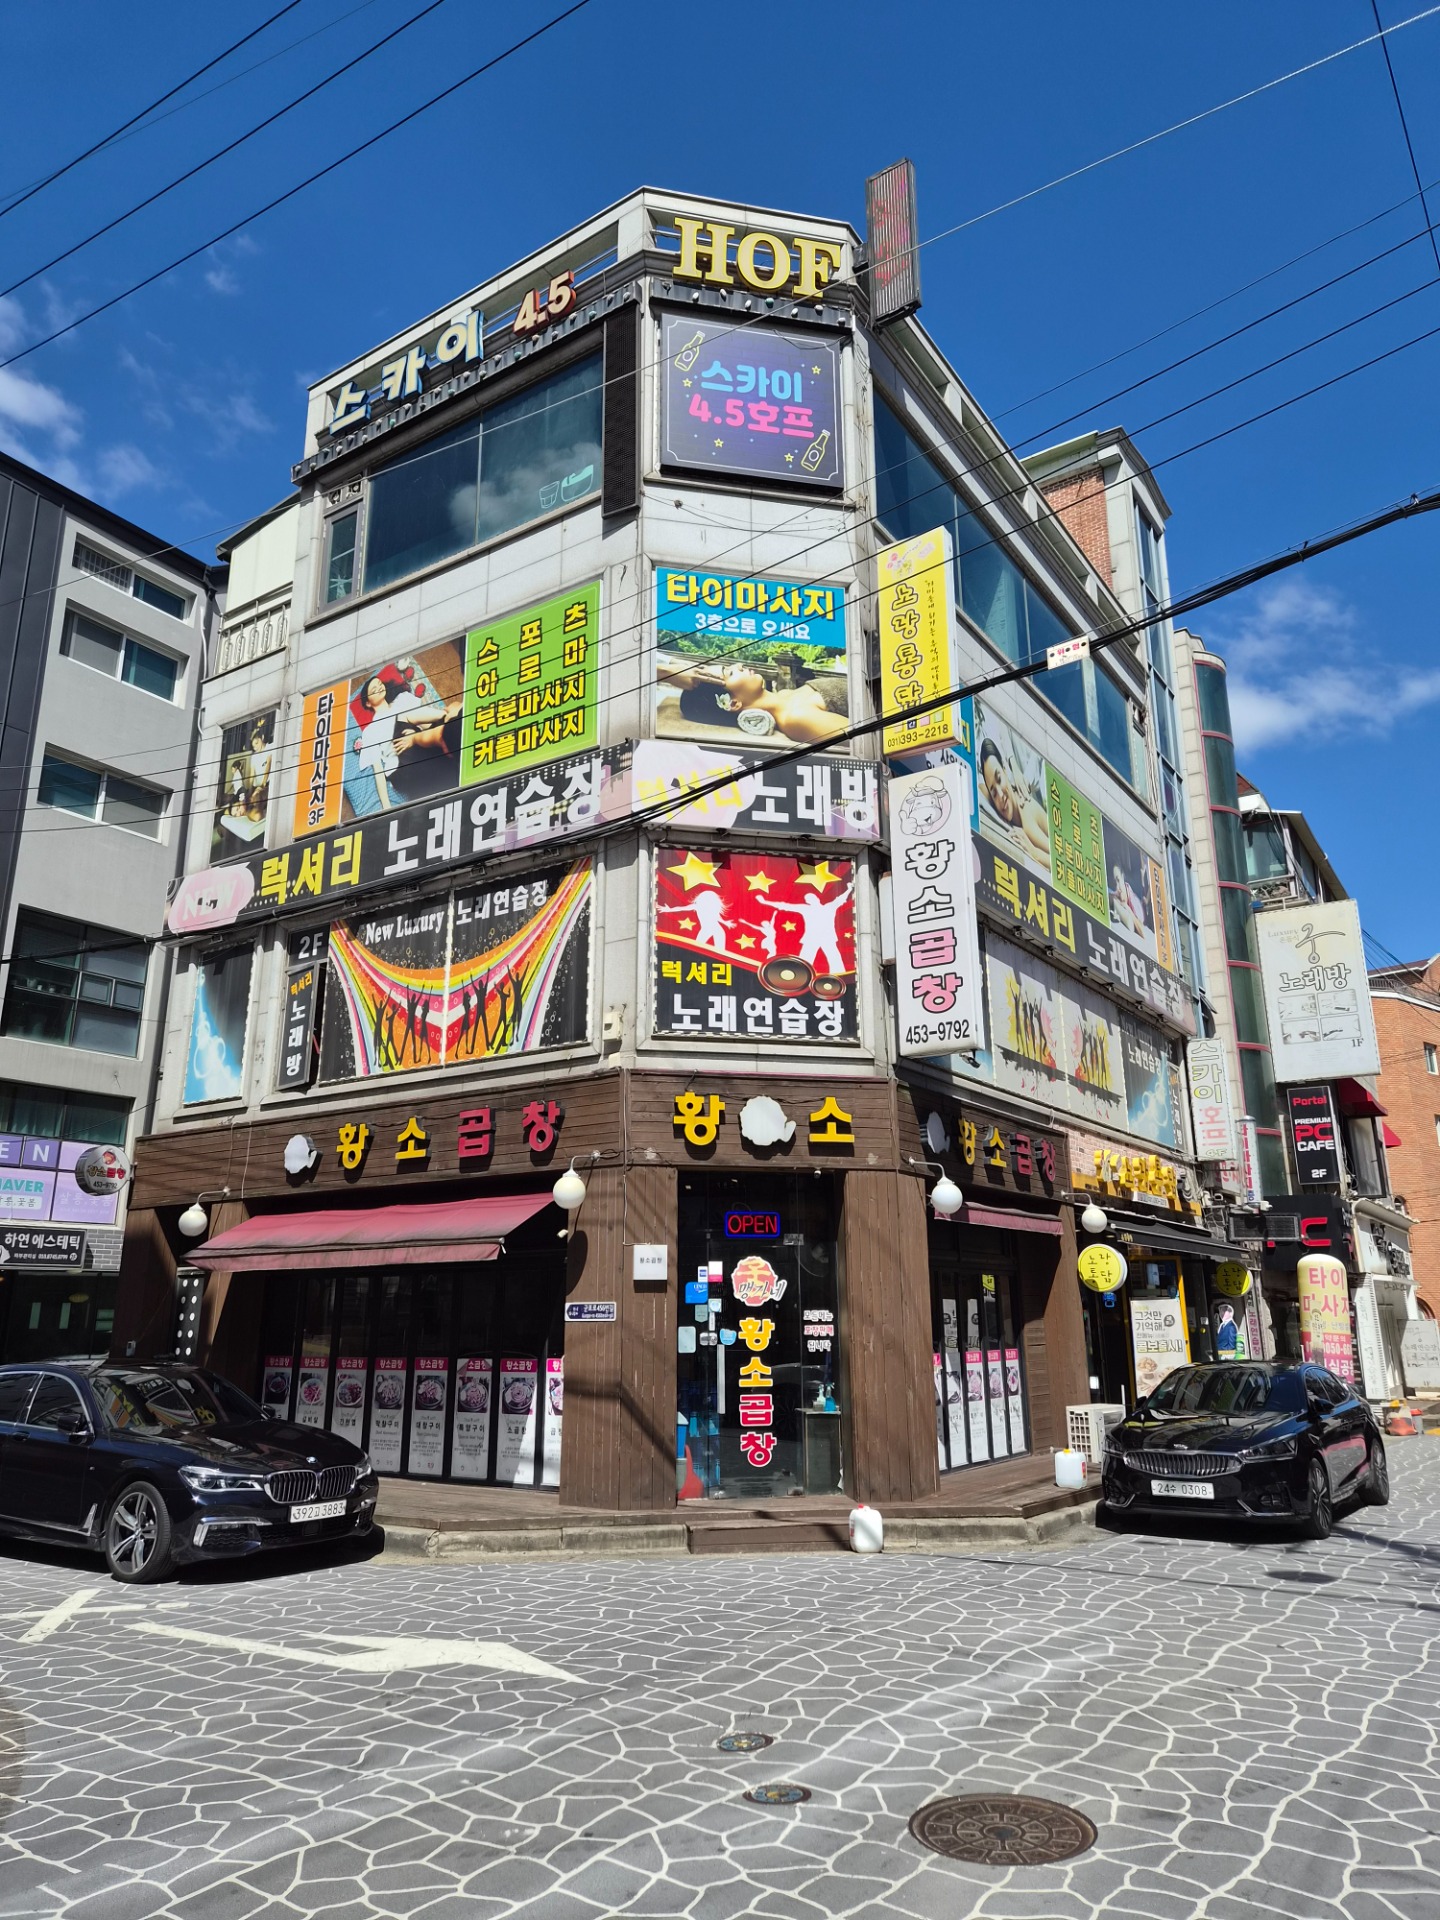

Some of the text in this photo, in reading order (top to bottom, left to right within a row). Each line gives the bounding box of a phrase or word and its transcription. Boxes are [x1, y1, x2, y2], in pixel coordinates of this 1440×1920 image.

[672, 217, 842, 299] HOF
[328, 270, 578, 436] 스카이 4.5
[700, 360, 805, 402] 스카이
[688, 393, 815, 439] 4.5호프
[665, 573, 835, 621] 타이마사지
[694, 612, 811, 641] 3층으로 오세요
[474, 672, 586, 732] 부분마사지
[472, 709, 586, 768] 커플마사지
[308, 692, 334, 826] 타이마사지 3F
[751, 758, 878, 830] 노래방
[260, 830, 363, 905] 럭셔리
[383, 758, 602, 876] 노래연습장
[456, 879, 549, 925] 노래연습장
[365, 909, 446, 945] New Luxury
[904, 838, 963, 1014] 황소곱창
[993, 855, 1185, 1021] 럭셔리 노래연습장
[298, 933, 324, 960] 2F
[661, 960, 733, 986] 럭셔리
[1279, 962, 1351, 993] 노래방
[671, 992, 845, 1037] 노래연습장
[286, 999, 306, 1077] 노래방
[905, 1018, 971, 1045] 453-9792
[1191, 1042, 1222, 1103] 스카이
[1293, 1095, 1328, 1106] Portal
[335, 1100, 562, 1170] 황소곱창
[673, 1092, 855, 1146] 황 소
[1199, 1106, 1228, 1147] 호프
[1295, 1117, 1332, 1126] PREMIUM
[1295, 1124, 1333, 1142] PC
[958, 1117, 1056, 1183] 황소곱창
[1297, 1139, 1336, 1152] CAFE
[88, 1164, 127, 1179] 황소곱창
[1311, 1168, 1328, 1179] 2F
[728, 1215, 778, 1234] OPEN
[4, 1233, 81, 1250] 하연 에스테틱
[1309, 1266, 1345, 1290] 타이
[803, 1310, 834, 1321] 모든메뉴
[1135, 1310, 1163, 1321] 그것만
[1136, 1321, 1166, 1332] 기억해.
[807, 1340, 832, 1352] 됩니다
[419, 1359, 445, 1369] 황소곱창
[505, 1360, 533, 1371] 황소곱창
[738, 1317, 777, 1467] 황소곱창
[1157, 1483, 1208, 1496] 24수 0308
[321, 1502, 345, 1517] 3883
